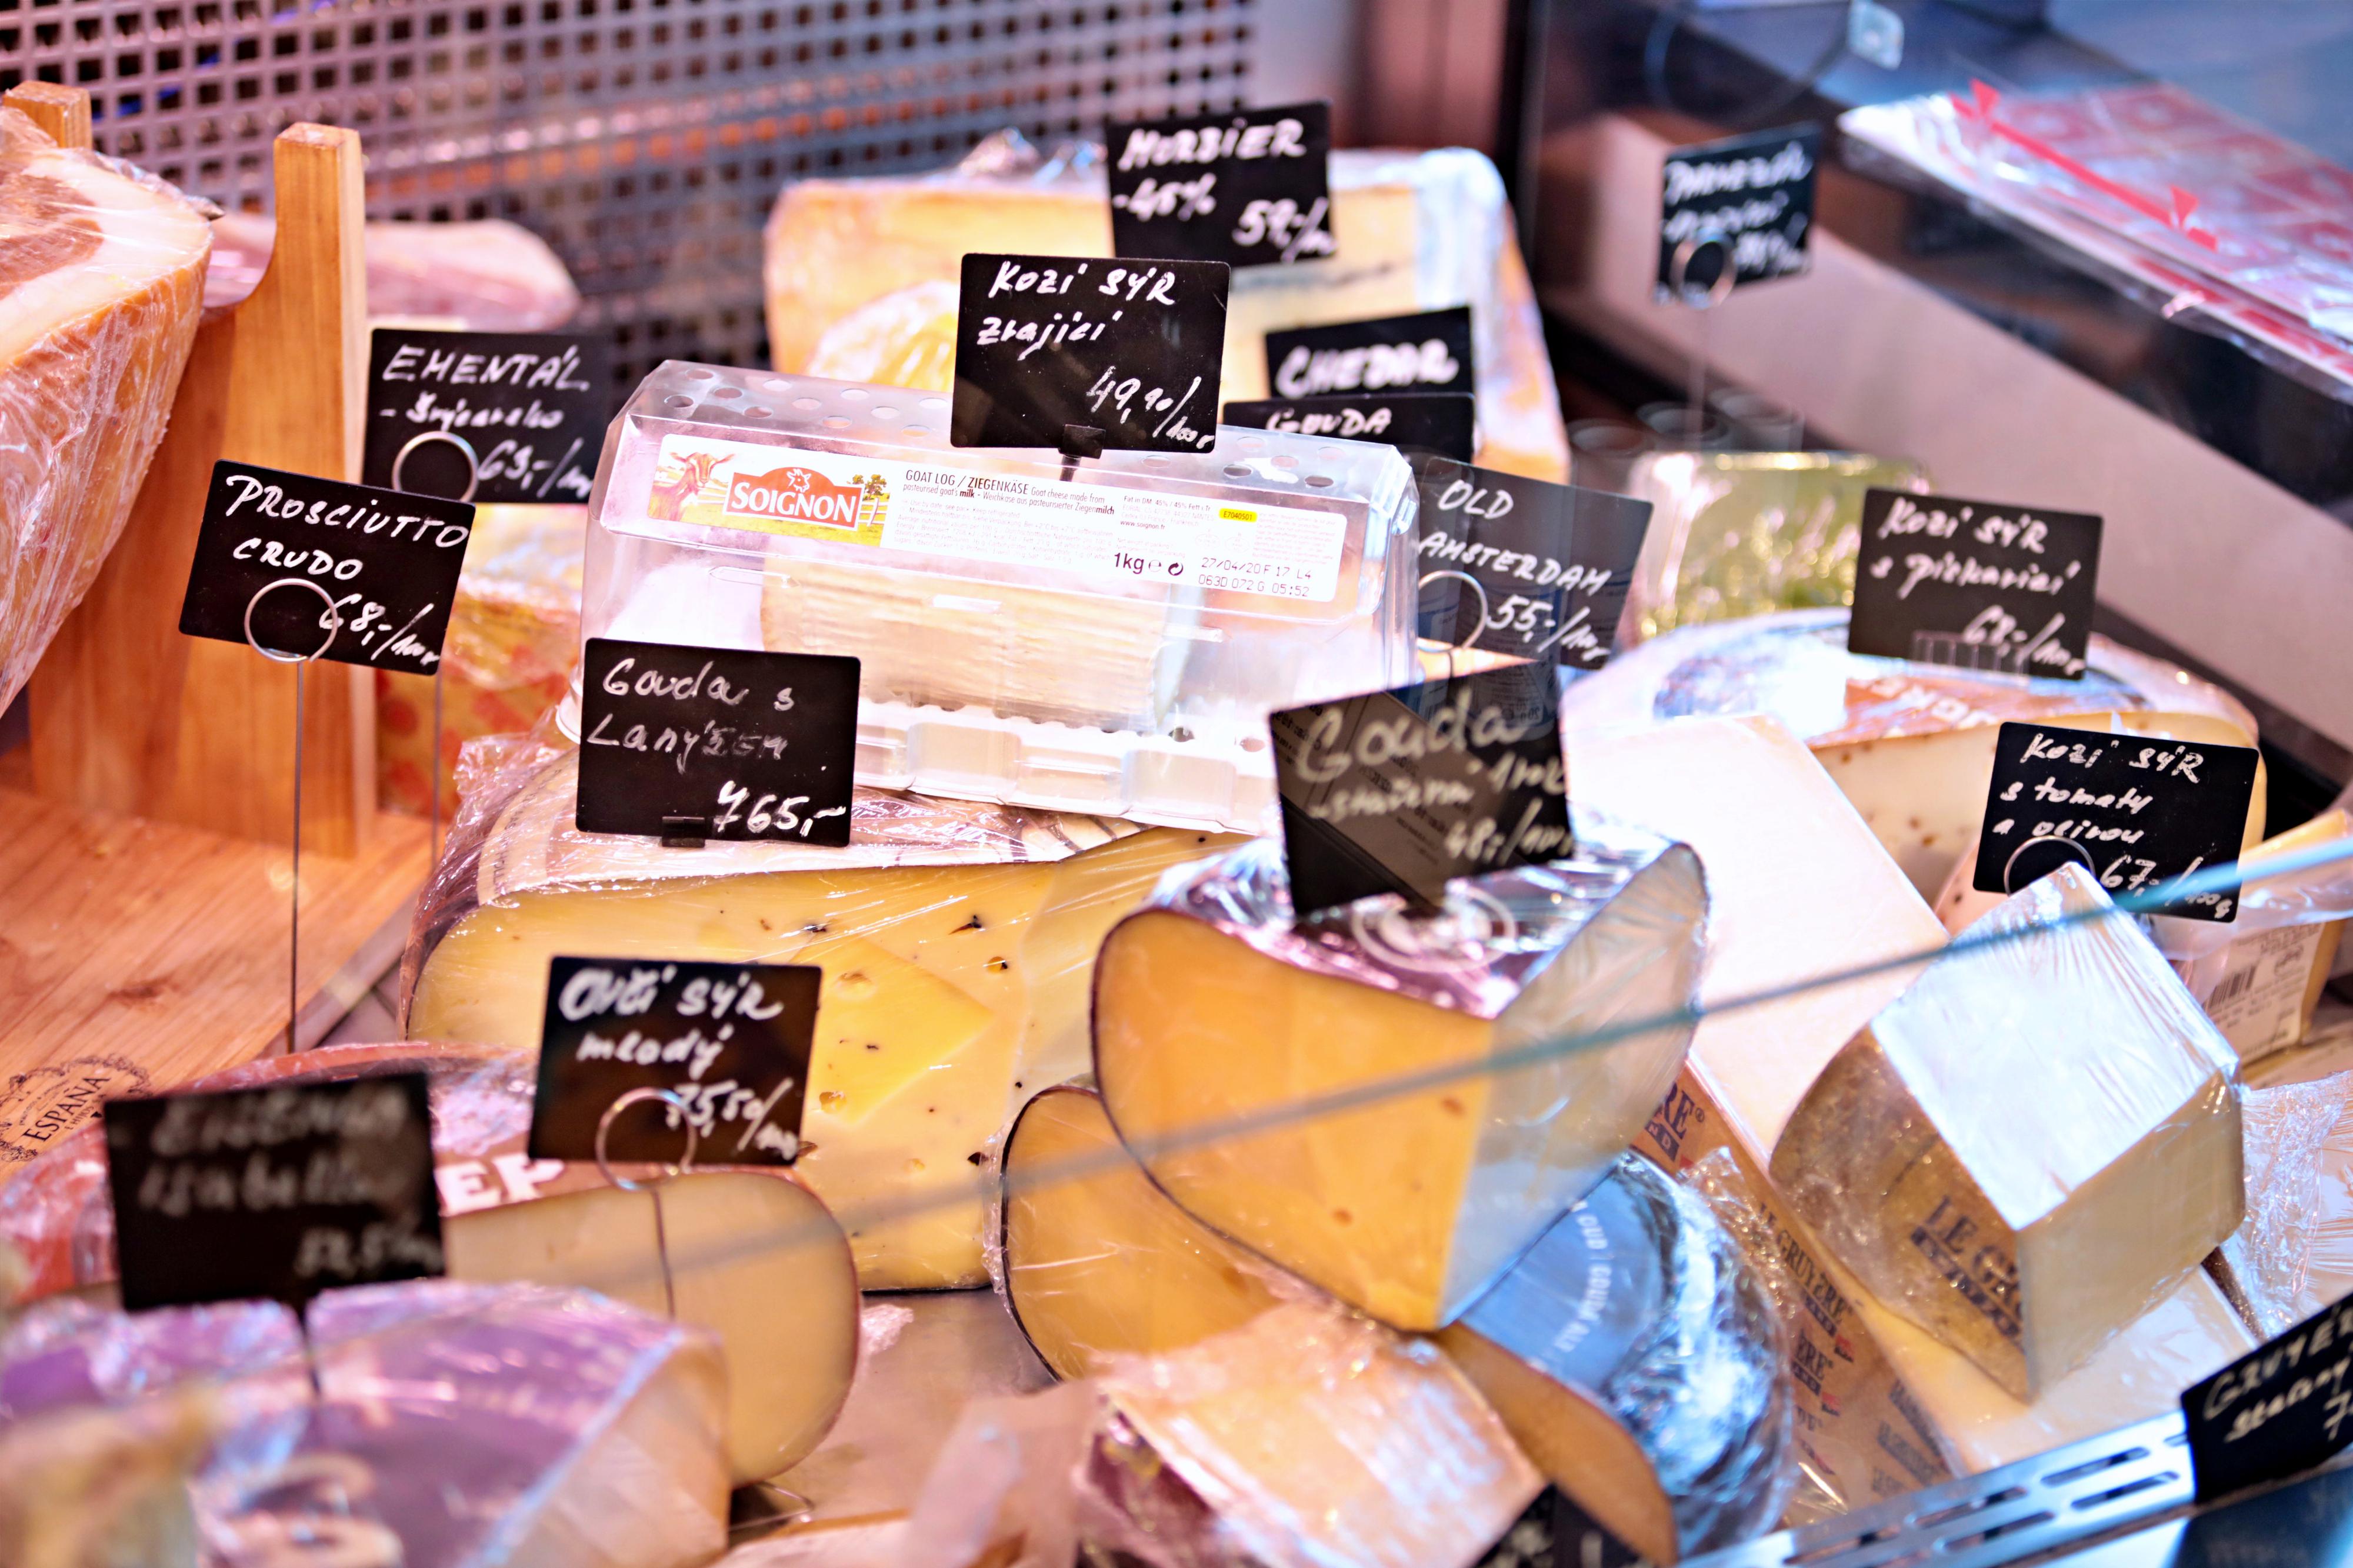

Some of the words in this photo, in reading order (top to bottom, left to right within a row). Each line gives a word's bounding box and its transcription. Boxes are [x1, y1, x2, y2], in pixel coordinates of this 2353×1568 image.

[1118, 118, 1307, 172] MORBIER
[1265, 407, 1392, 438] GOUDA
[731, 481, 857, 523] SOIGNON
[903, 482, 939, 495] pasteurised
[959, 489, 975, 499] milk
[1016, 496, 1028, 505] aus
[1074, 502, 1115, 515] Ziegenmilch
[905, 469, 933, 483] GOAT
[935, 473, 955, 486] LOG
[967, 477, 1030, 495] ZIEGENKÄSE
[1031, 486, 1046, 497] Goat
[1047, 488, 1069, 501] cheese
[1069, 491, 1088, 502] made
[1089, 494, 1105, 504] from
[1437, 479, 1514, 519] OLD
[225, 474, 469, 548] PROSCIUTTO
[233, 538, 363, 581] CRUDO
[1114, 552, 1145, 575] 1kg
[1416, 531, 1612, 596] AMSTERDAM
[1231, 578, 1254, 590] 072
[1271, 582, 1310, 597] 05:52
[602, 657, 751, 705] Gouda
[22, 1077, 112, 1142] ESPAÑA
